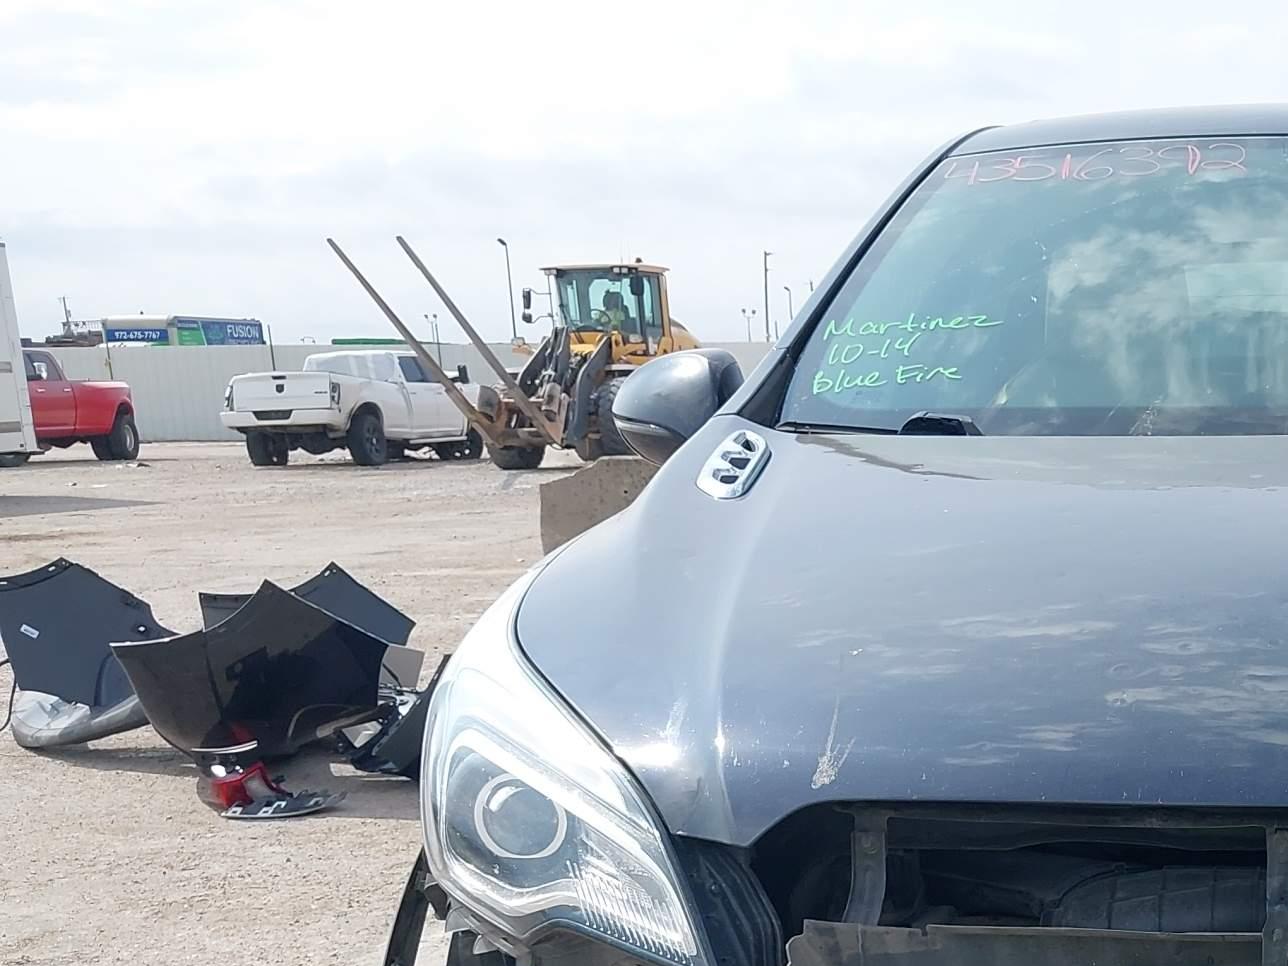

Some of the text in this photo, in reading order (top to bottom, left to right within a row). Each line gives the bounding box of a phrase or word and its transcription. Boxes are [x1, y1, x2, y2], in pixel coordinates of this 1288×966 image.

[944, 143, 1247, 185] 43516392
[226, 324, 260, 339] FUSION
[823, 313, 1004, 340] Martinez
[828, 332, 921, 365] 10-14
[813, 369, 887, 395] Blue
